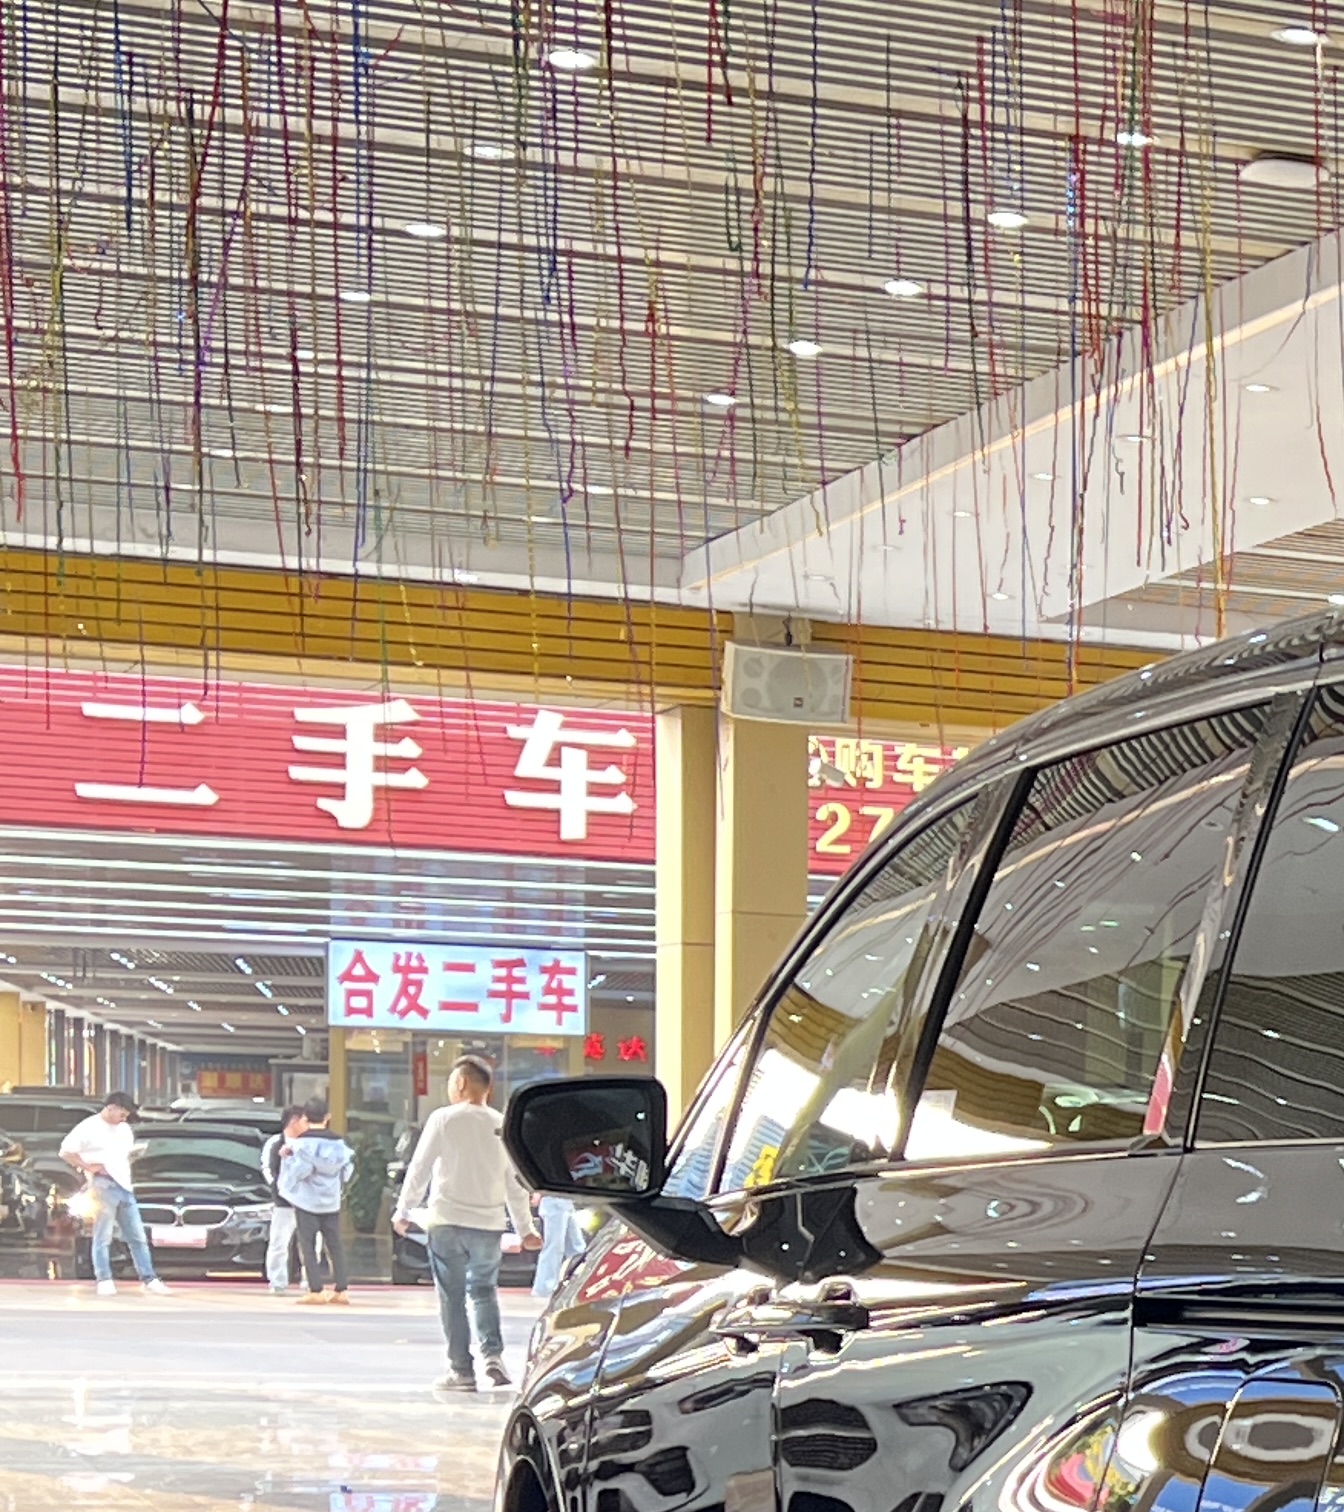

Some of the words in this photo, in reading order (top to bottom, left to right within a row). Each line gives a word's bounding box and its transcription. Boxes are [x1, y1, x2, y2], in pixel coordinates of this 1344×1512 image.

[74, 698, 638, 840] 二手车
[808, 736, 969, 792] 购车
[336, 948, 579, 1026] 合发二手车
